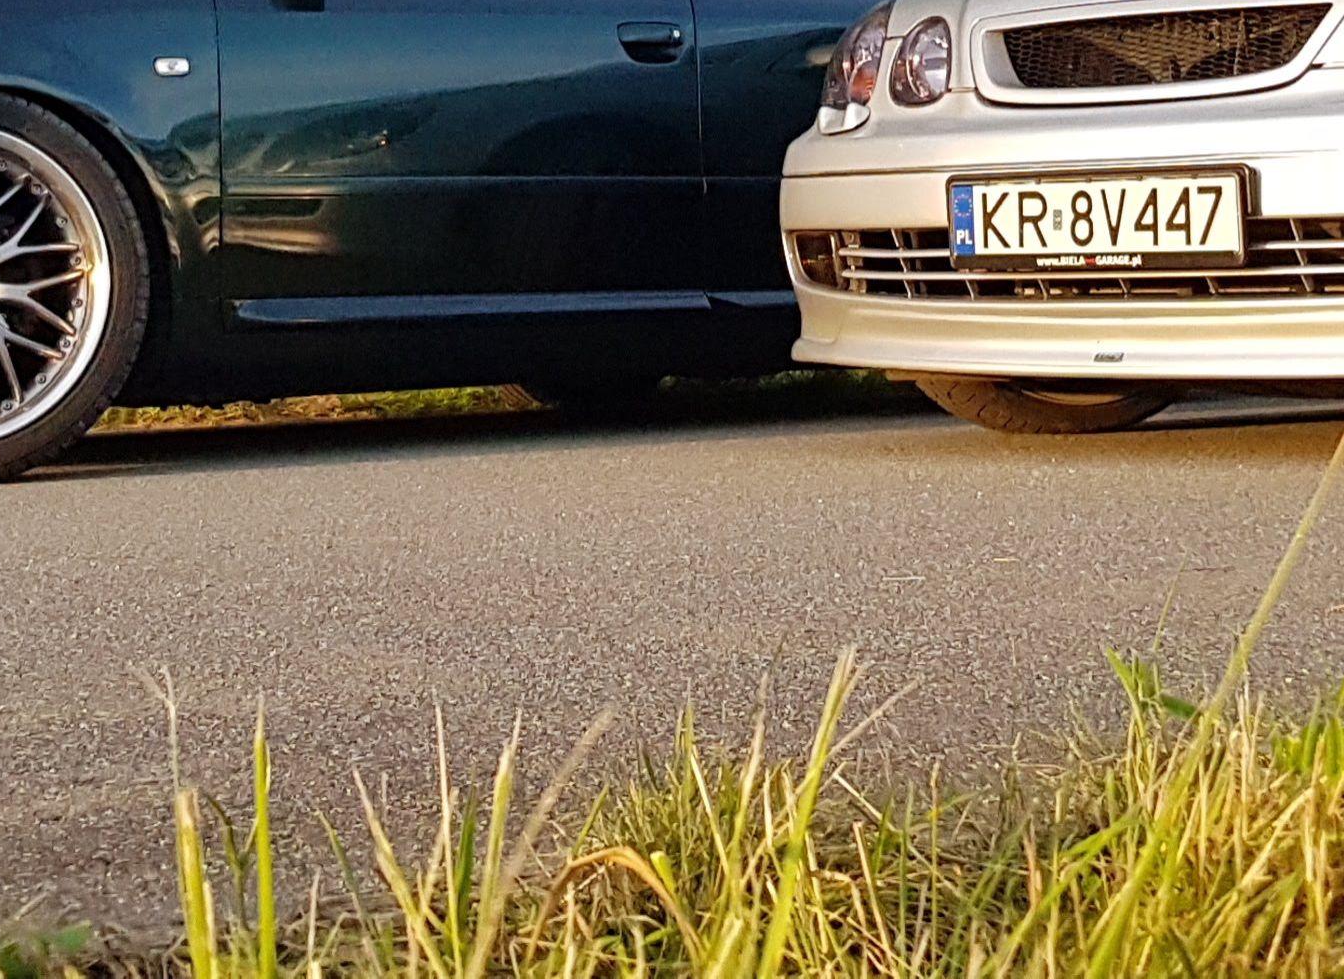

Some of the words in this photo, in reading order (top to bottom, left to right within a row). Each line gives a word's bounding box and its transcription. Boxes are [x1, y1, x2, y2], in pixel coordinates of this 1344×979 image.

[956, 229, 973, 245] PL
[981, 191, 1048, 249] KR
[1070, 185, 1223, 248] 8V447
